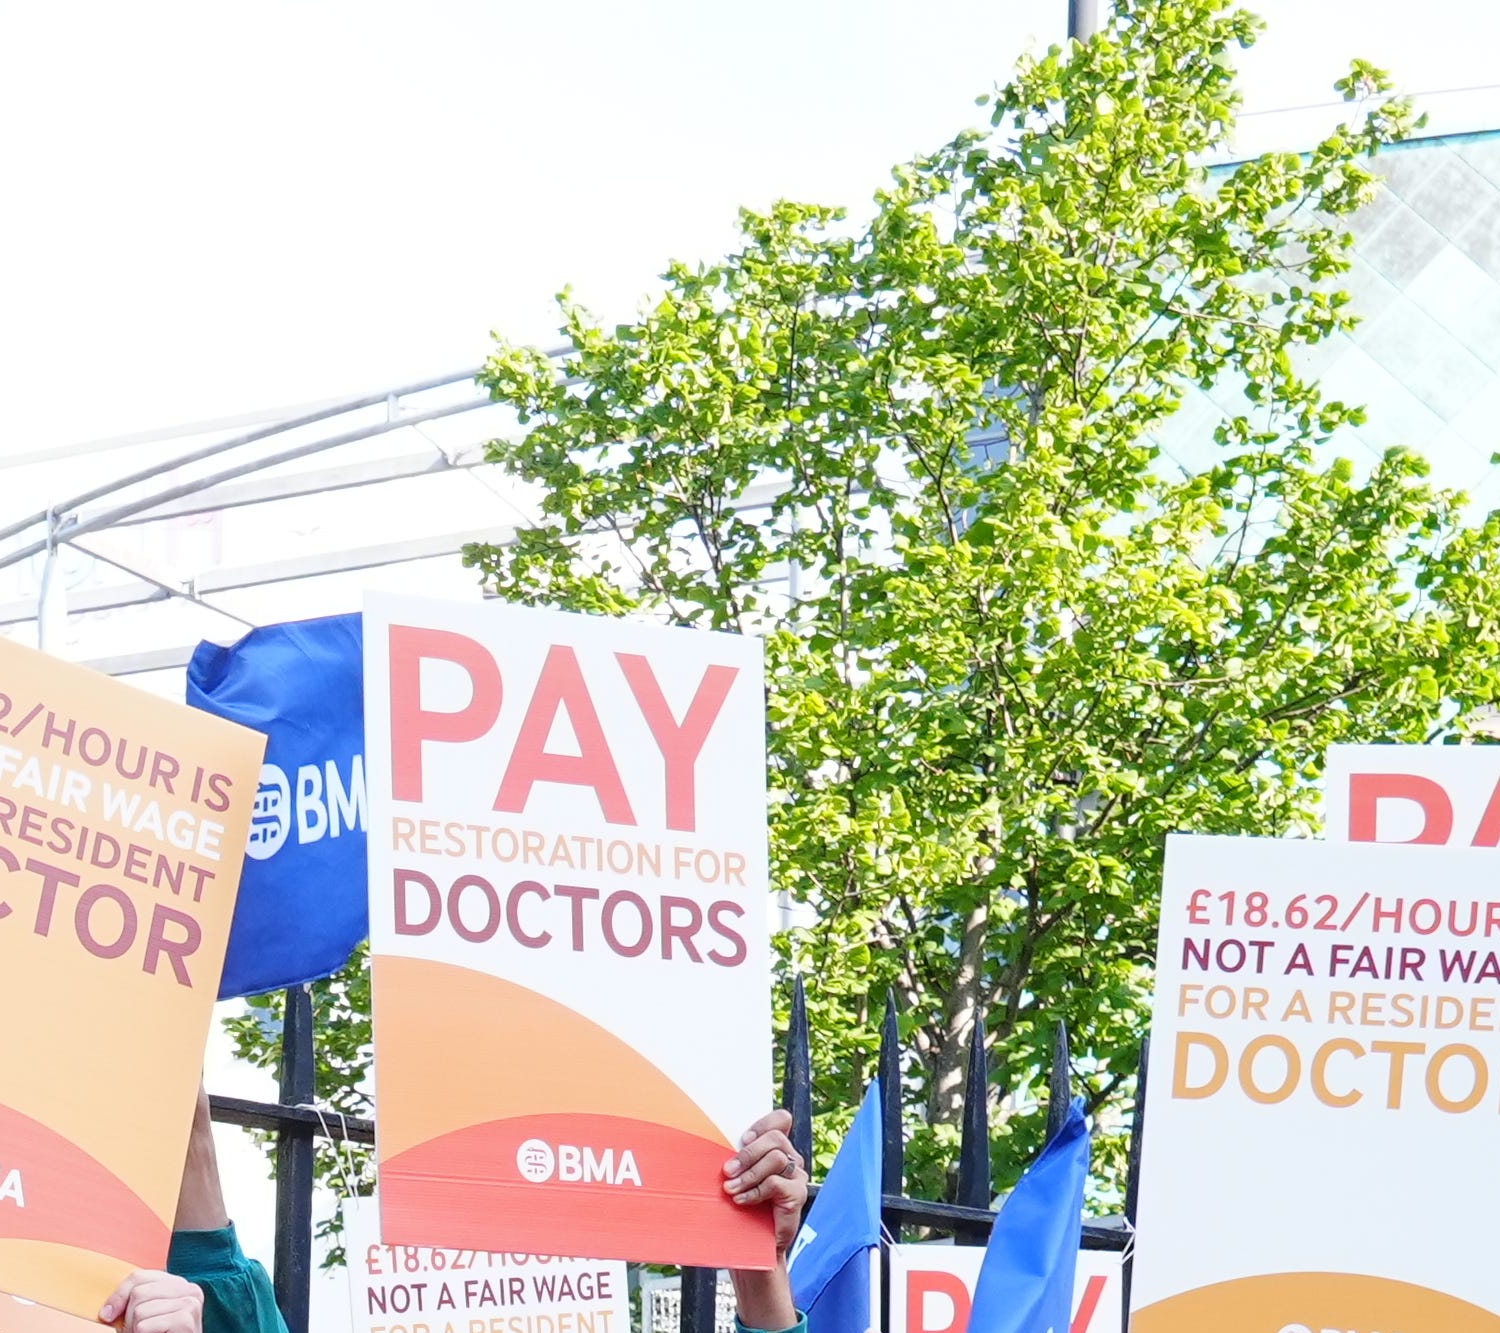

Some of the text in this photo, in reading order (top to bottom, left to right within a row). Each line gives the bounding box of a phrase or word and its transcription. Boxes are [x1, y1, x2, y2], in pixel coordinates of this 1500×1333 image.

[389, 624, 739, 832] PAY
[191, 767, 232, 812] IS
[296, 754, 367, 845] BM
[103, 783, 224, 860] WAGE
[393, 817, 745, 886] RESTORATION FOR
[394, 868, 747, 967] DOCTORS
[1182, 938, 1275, 973] NOT
[1284, 943, 1314, 976] A
[1330, 945, 1425, 981] FAIR
[1178, 984, 1269, 1020] FOR
[1281, 990, 1312, 1022] A
[559, 1145, 641, 1186] BMA
[368, 1272, 612, 1314] NOT A FAIR WAGE
